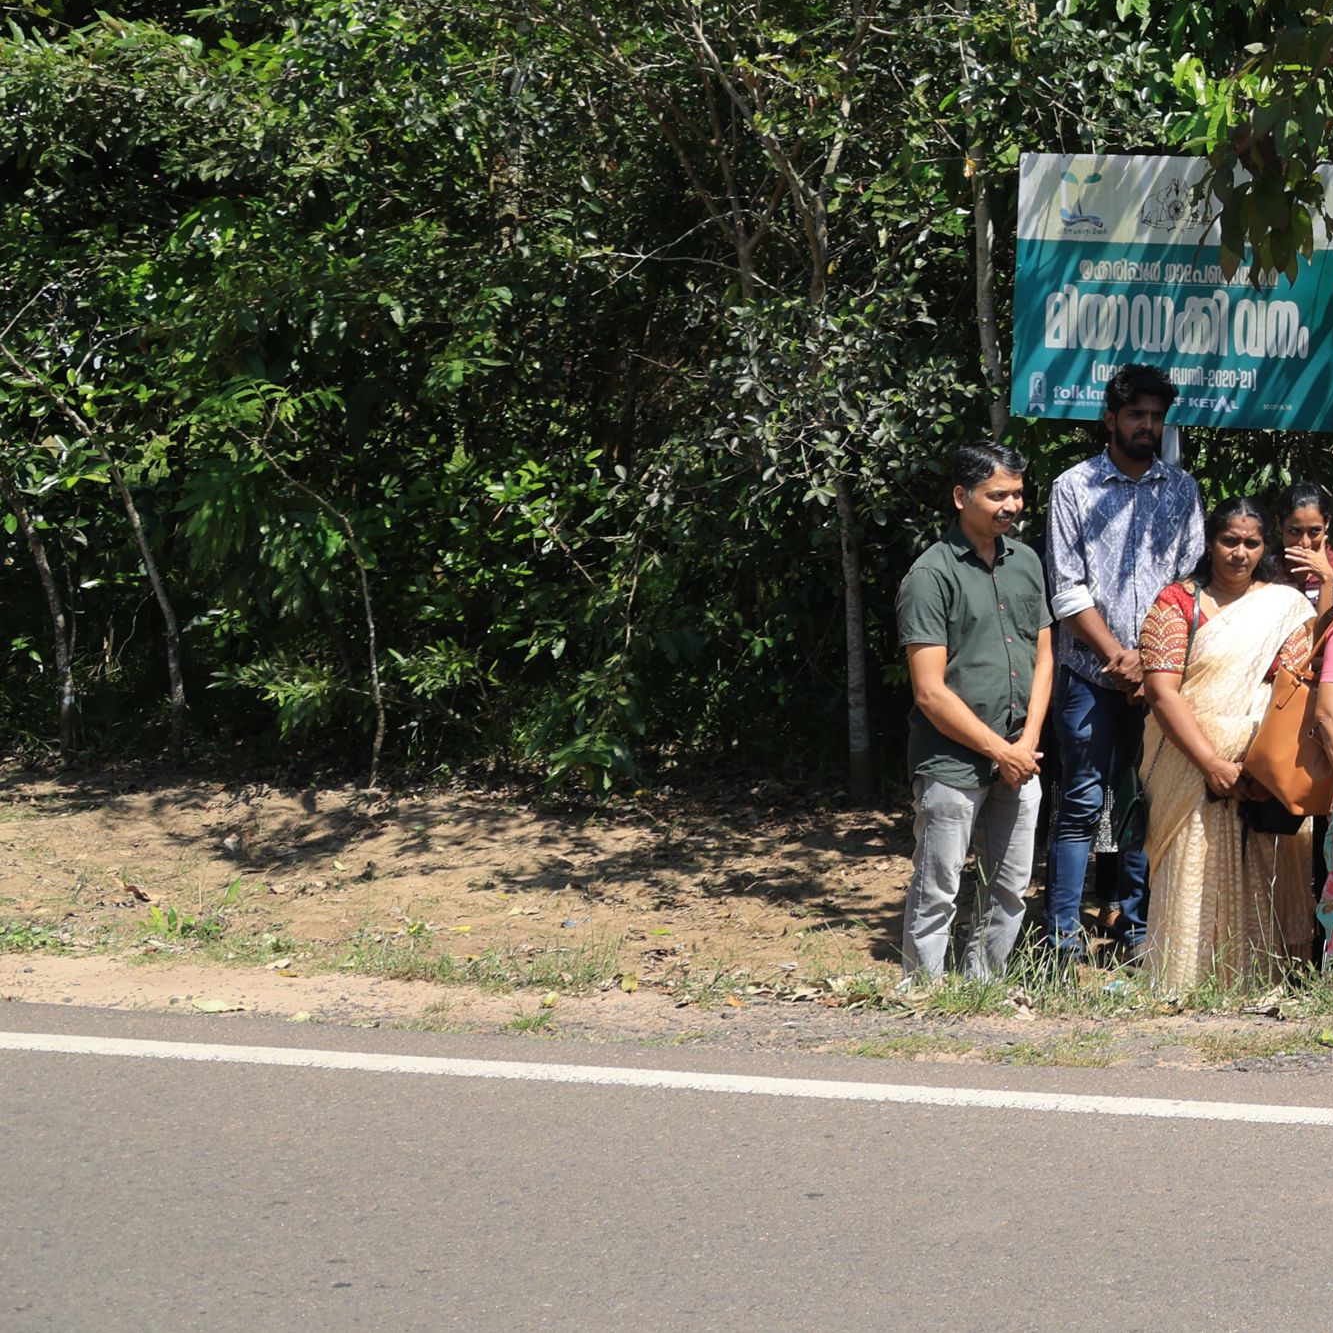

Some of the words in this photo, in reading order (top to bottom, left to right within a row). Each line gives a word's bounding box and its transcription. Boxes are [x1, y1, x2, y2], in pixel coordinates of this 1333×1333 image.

[1044, 283, 1230, 357] മിയാവാക്കി
[1233, 297, 1310, 360] വനം
[1188, 395, 1239, 413] KETAL
